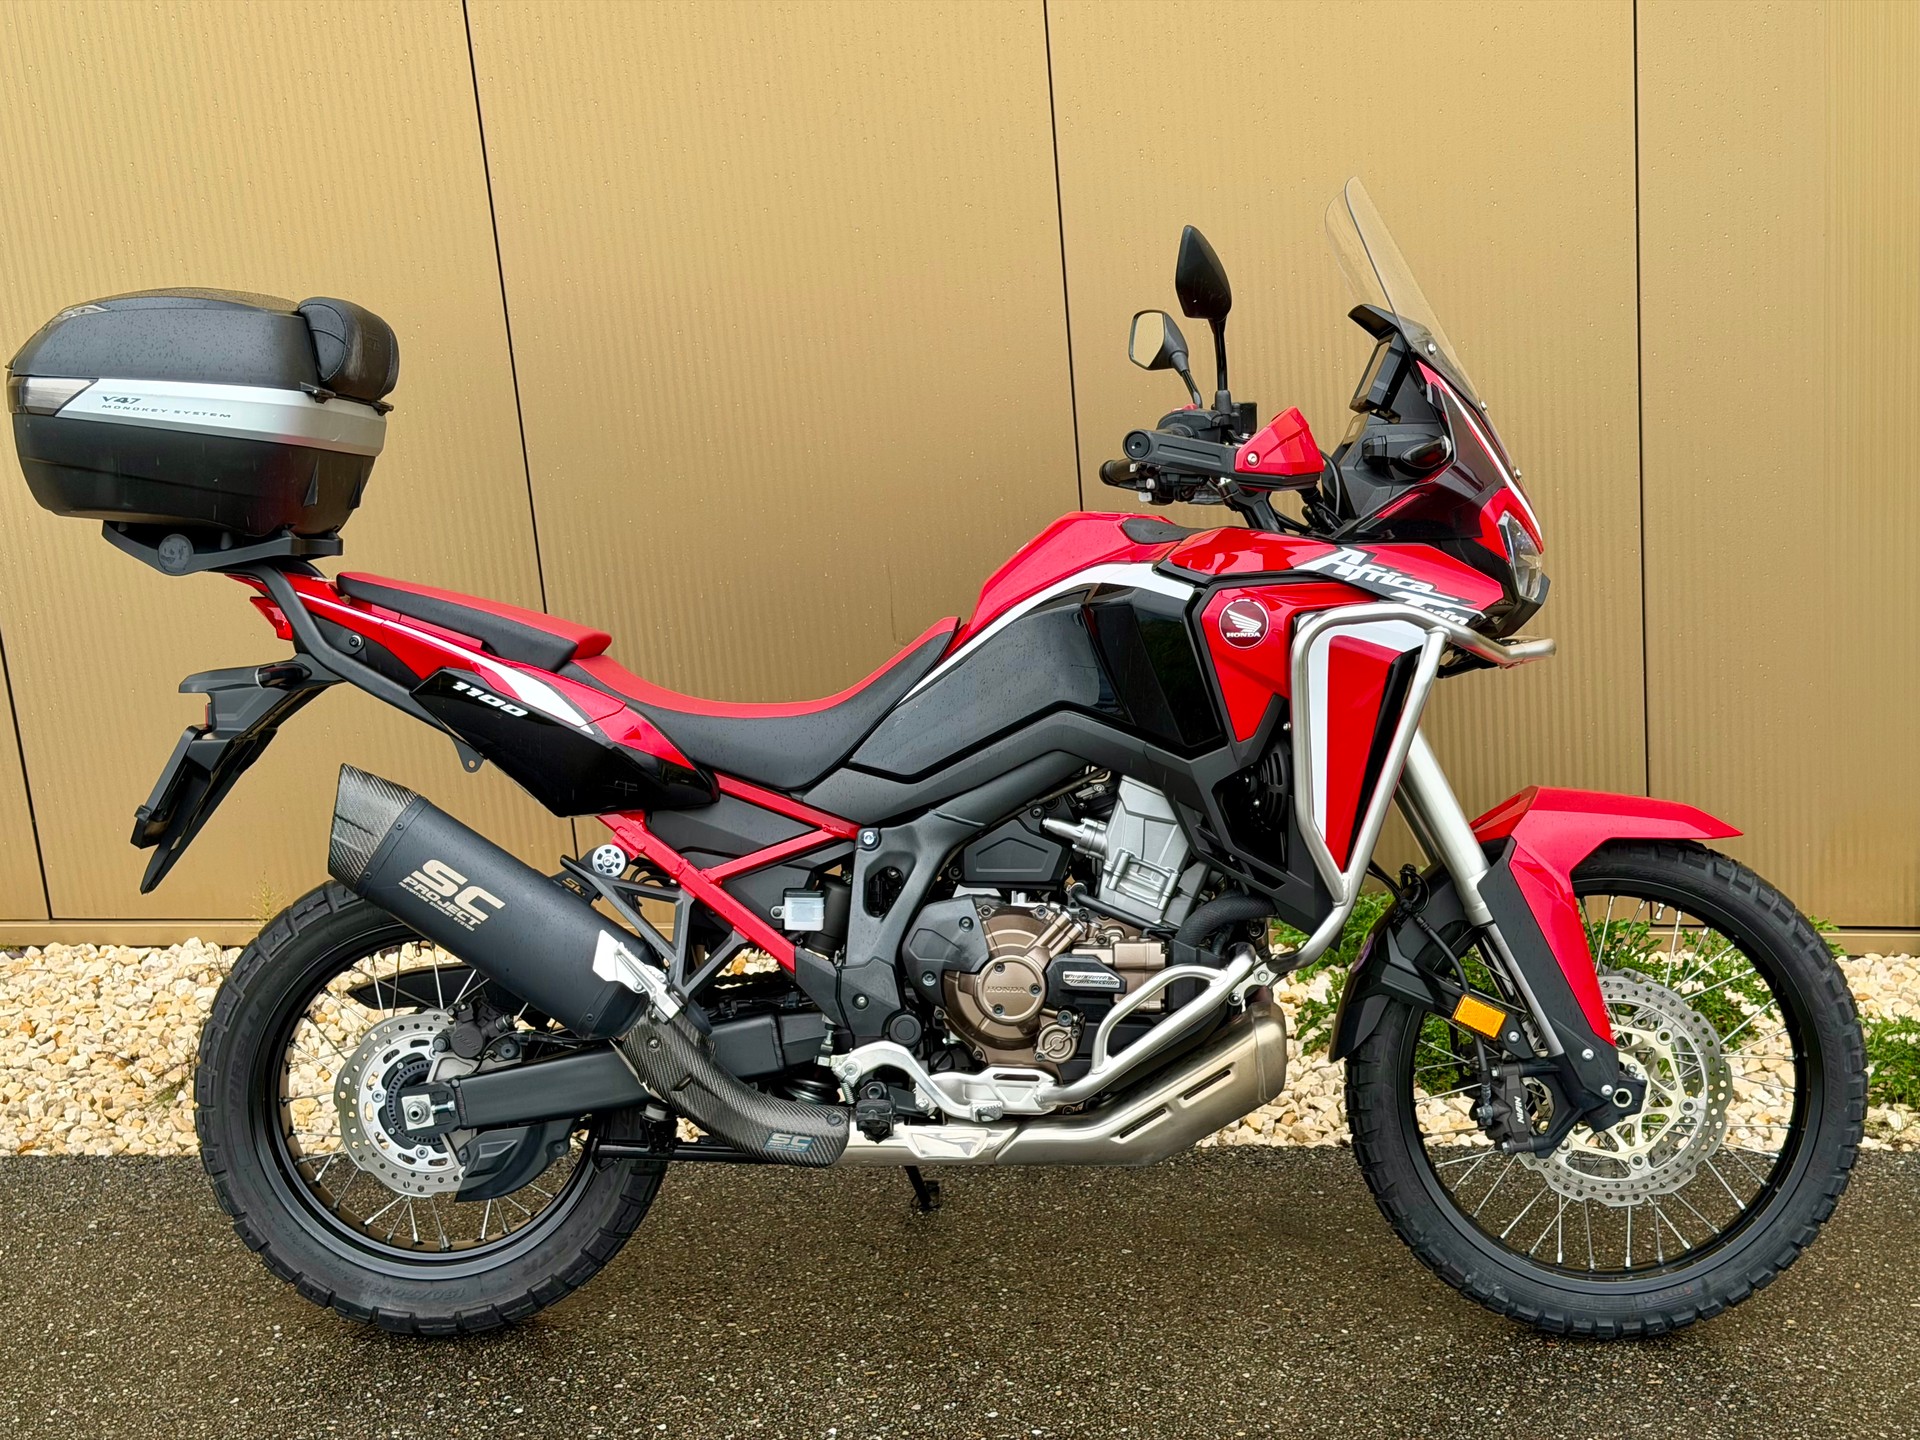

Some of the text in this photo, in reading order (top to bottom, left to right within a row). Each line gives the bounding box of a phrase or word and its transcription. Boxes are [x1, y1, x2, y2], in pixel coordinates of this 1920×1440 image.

[101, 404, 231, 418] MONOKEY SYSTEM
[102, 396, 142, 405] V47
[1294, 546, 1459, 601] Africa
[452, 680, 529, 717] 1100
[402, 876, 482, 926] PROJECT
[410, 859, 506, 922] SC
[986, 985, 1028, 994] HONDA
[769, 1132, 812, 1147] SC
